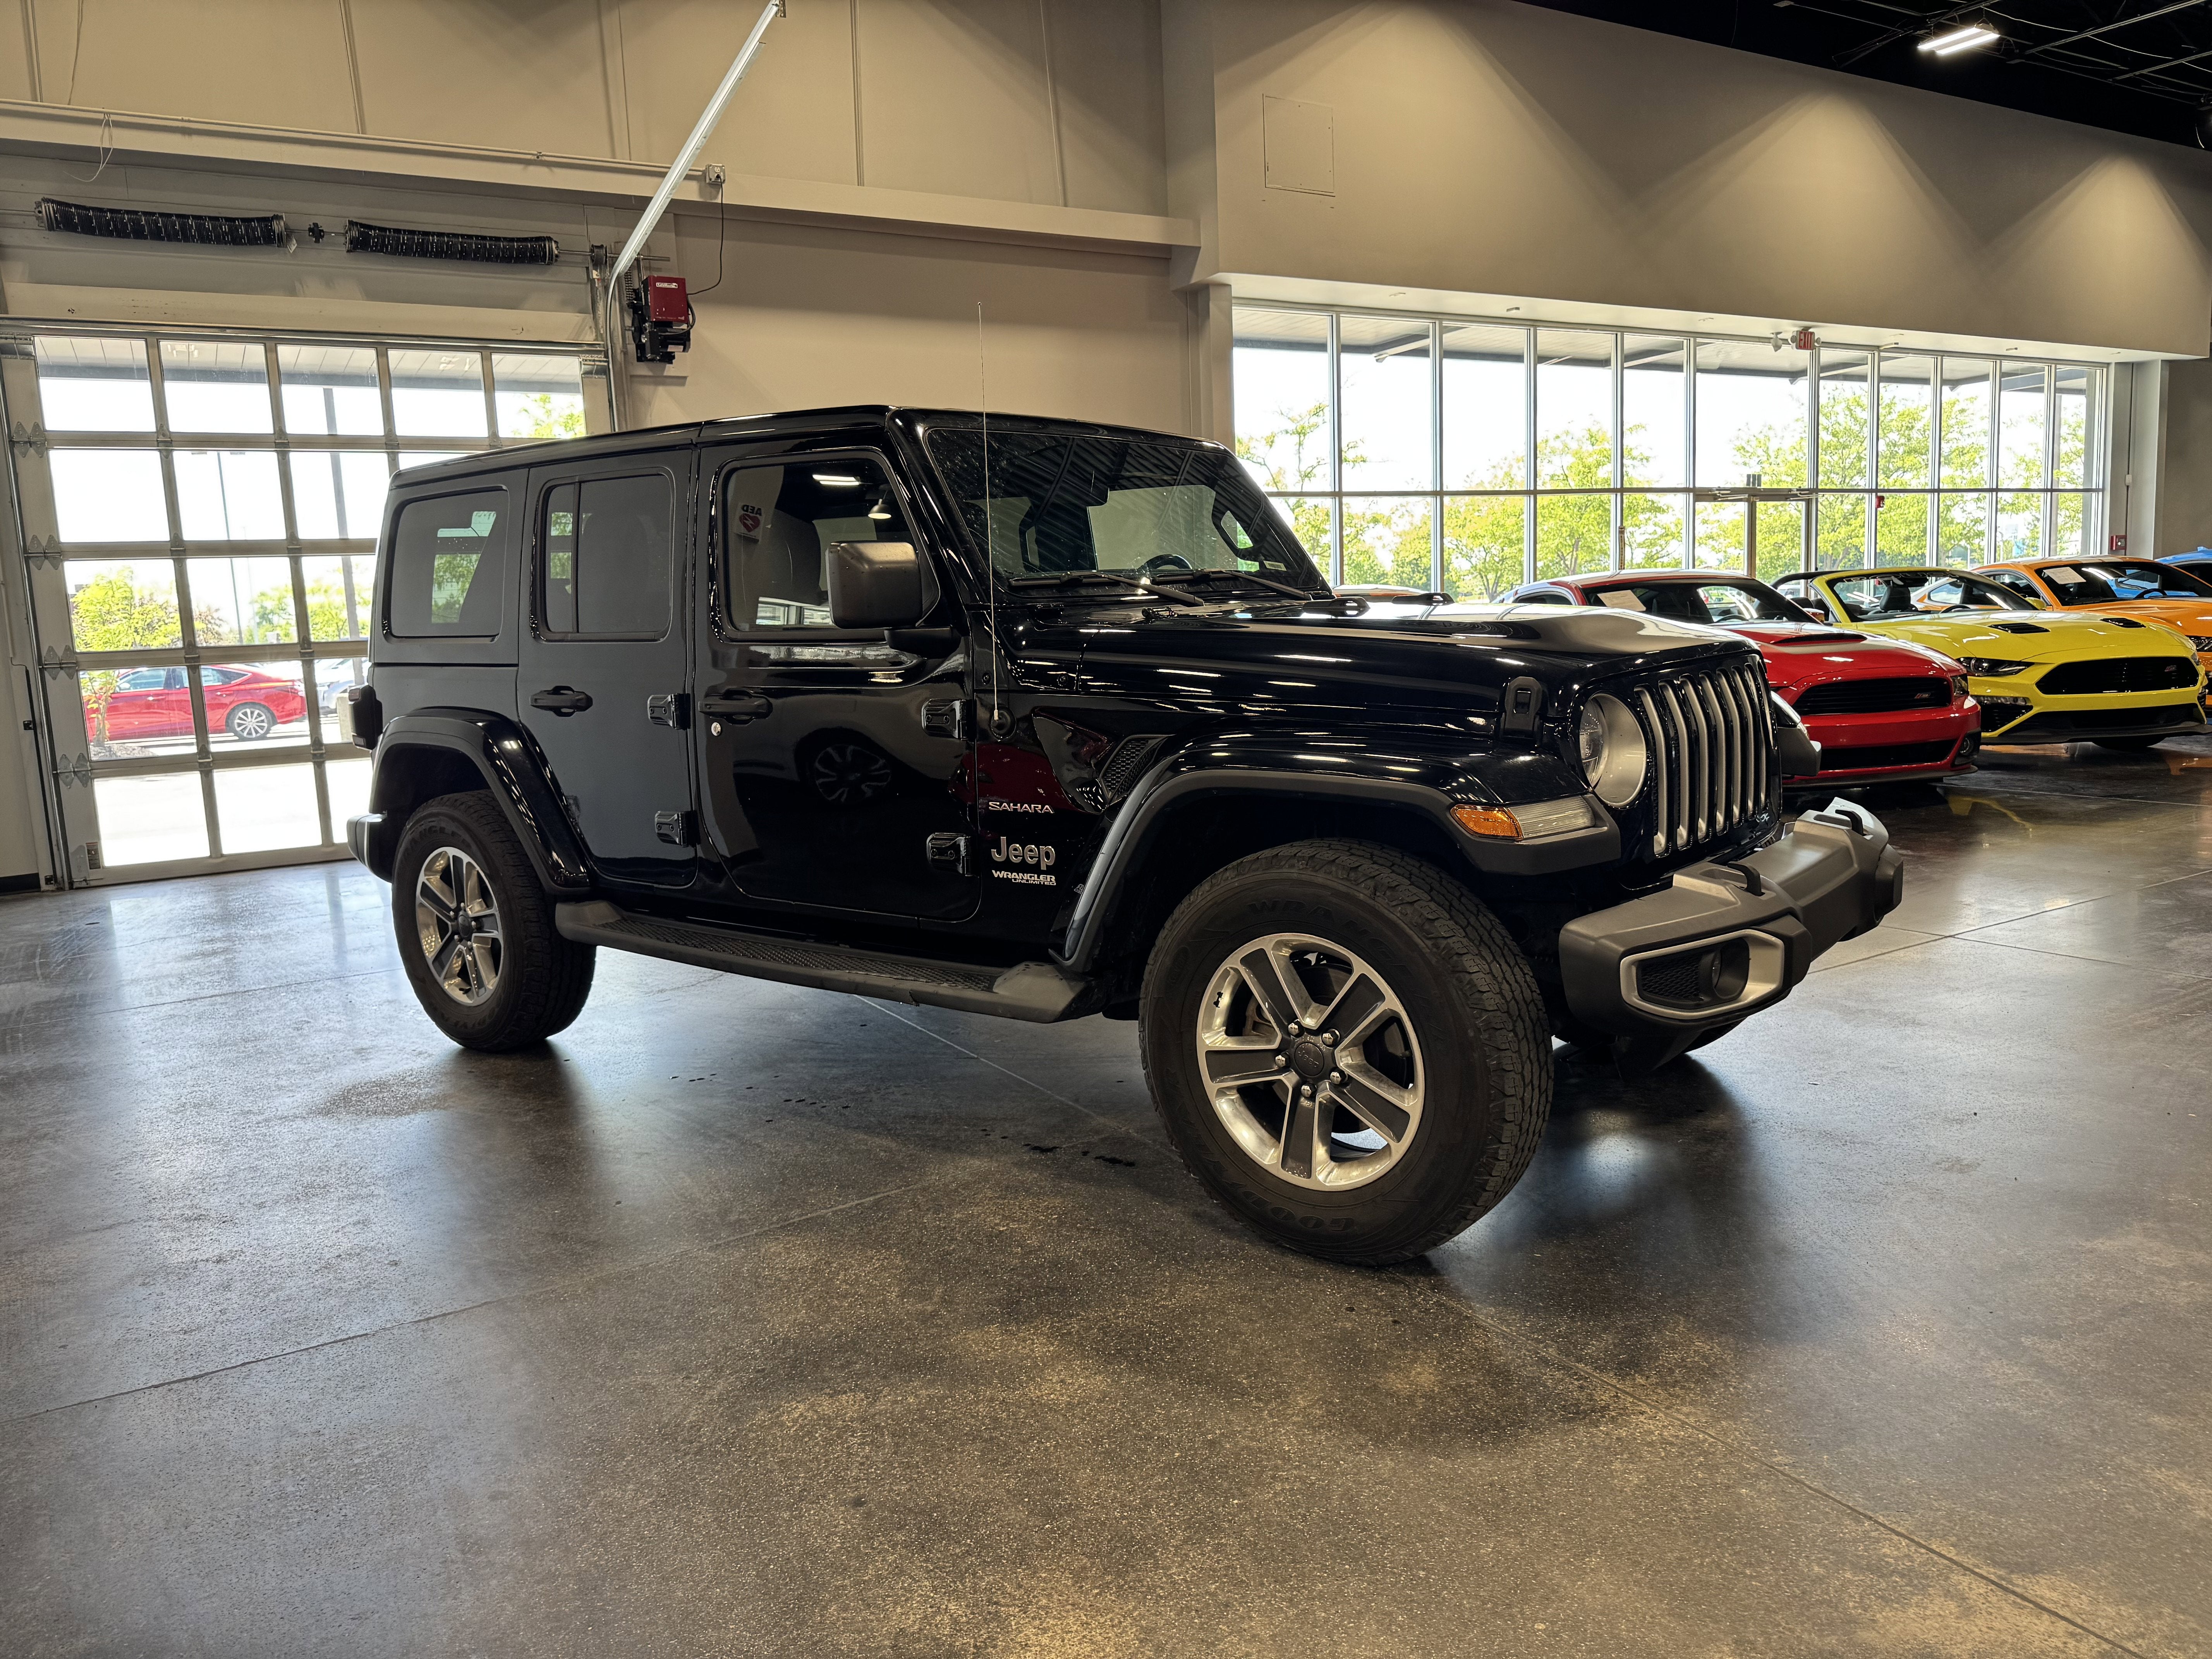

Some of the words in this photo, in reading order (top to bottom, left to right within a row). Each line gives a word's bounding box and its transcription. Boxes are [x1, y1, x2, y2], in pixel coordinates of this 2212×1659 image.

[1799, 331, 1813, 349] EXIT
[989, 802, 1054, 814] SAHARA
[991, 836, 1056, 870] Jeep
[992, 870, 1056, 882] WRANGLER
